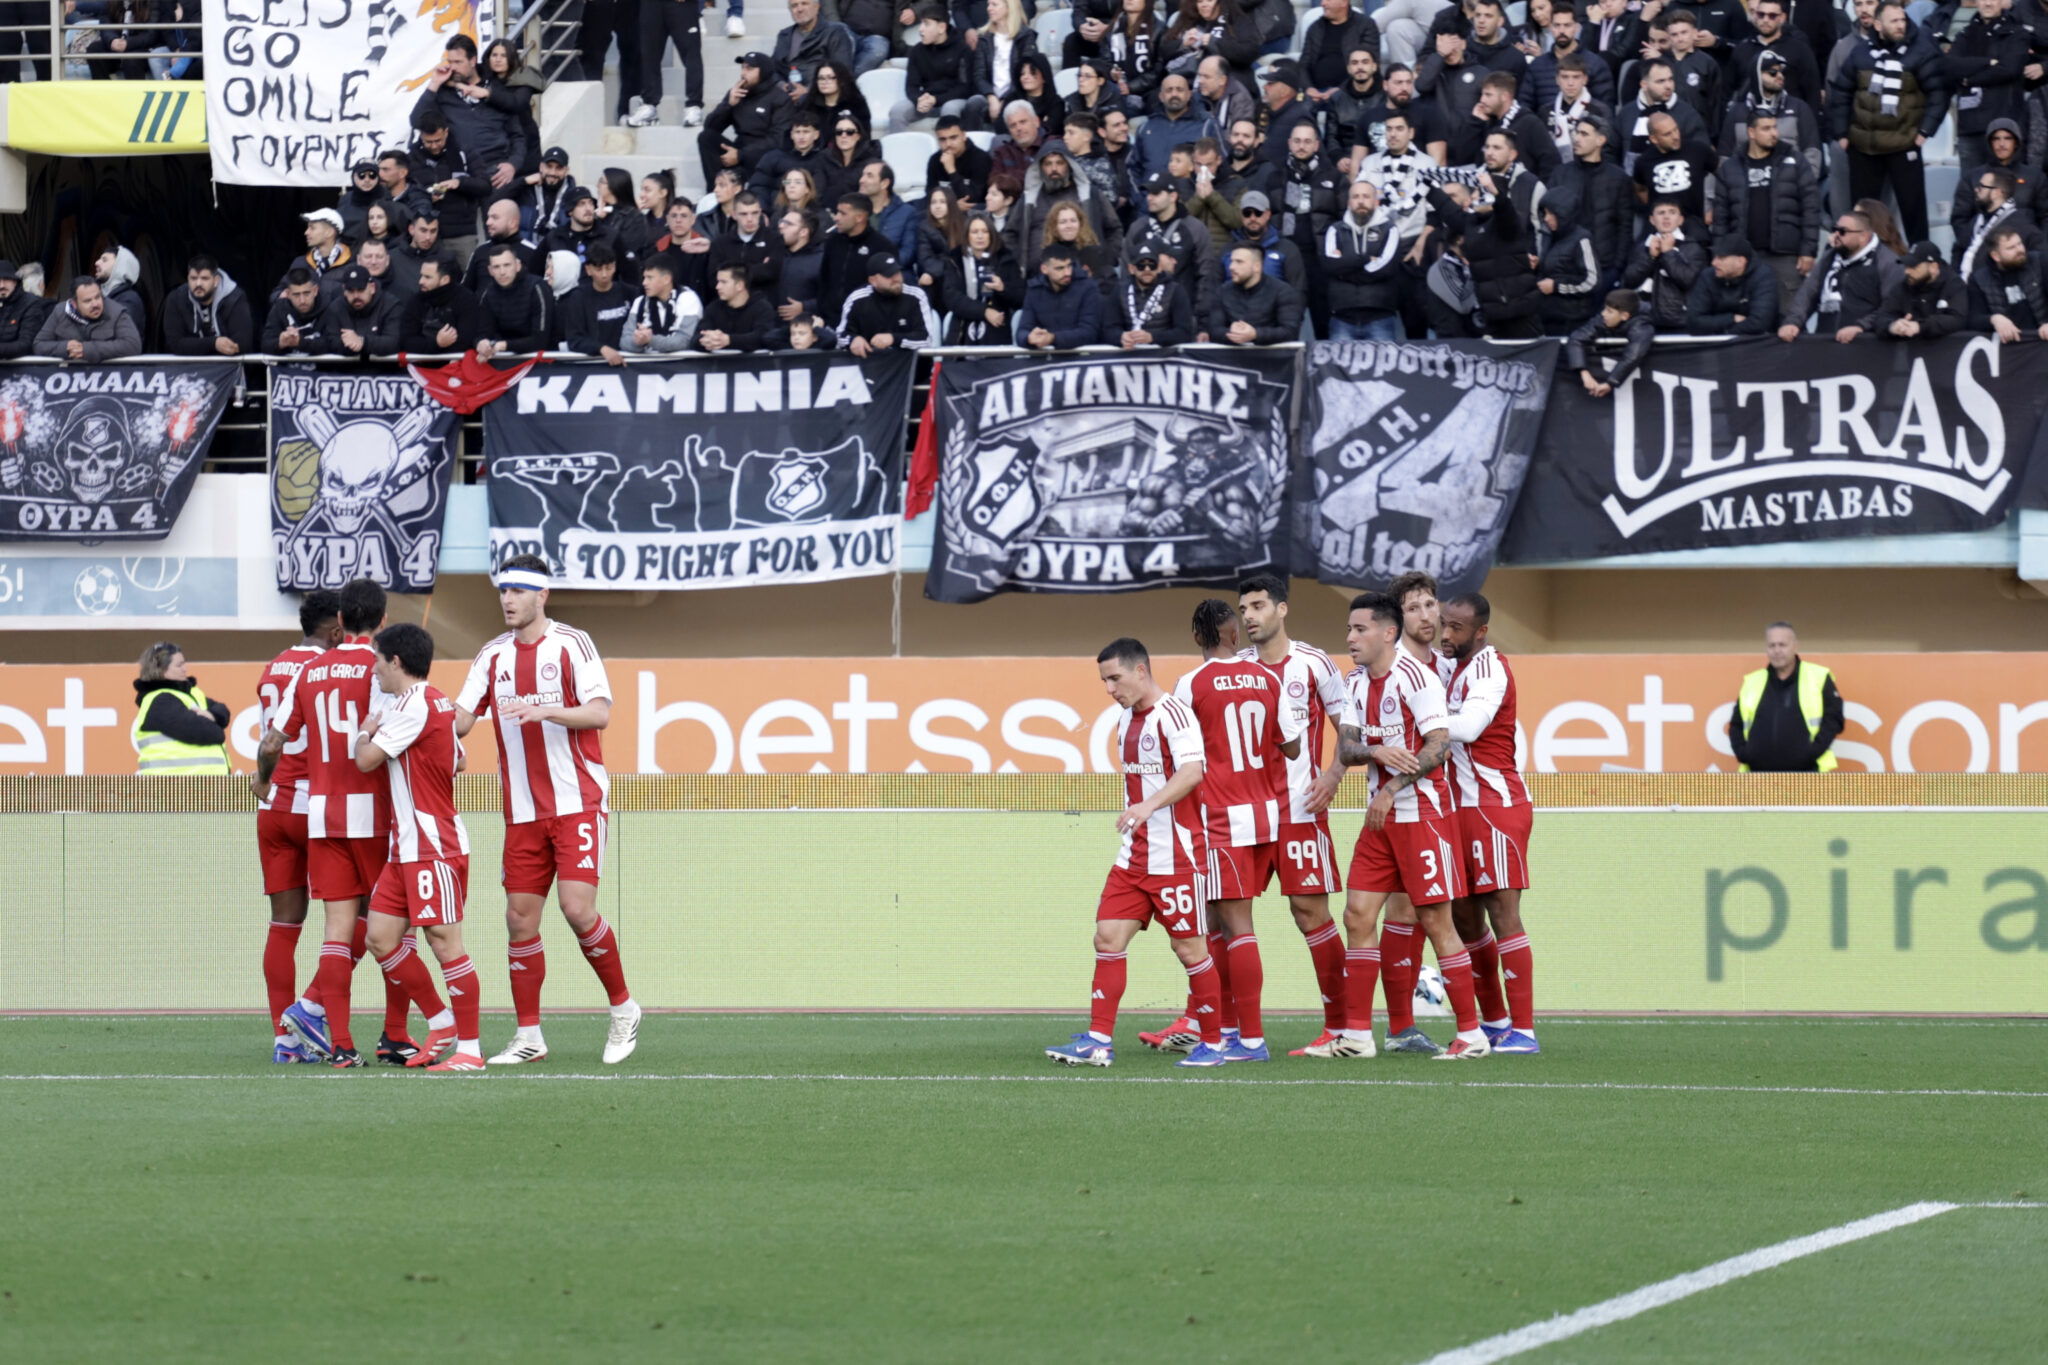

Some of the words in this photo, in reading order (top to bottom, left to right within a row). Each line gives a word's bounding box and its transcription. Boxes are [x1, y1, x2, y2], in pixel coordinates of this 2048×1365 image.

[223, 26, 300, 69] GO
[223, 69, 371, 123] OMILE
[45, 371, 171, 395] ΟΜΑΛΑ
[1313, 341, 1451, 378] support
[1451, 354, 1537, 392] your
[517, 365, 873, 414] KAMINIA
[979, 376, 1029, 430] ΑΙ
[1039, 364, 1250, 418] ΓΙΑΝΝΗΣ
[1602, 333, 2006, 499] ULTRAS
[515, 456, 599, 469] A.C.A.B
[18, 506, 118, 531] ΘΥΡΑ
[130, 503, 157, 529] 4
[1700, 484, 1913, 532] MASTABAS
[403, 532, 438, 586] 4
[578, 544, 626, 581] TO
[634, 541, 741, 581] FIGHT
[747, 535, 819, 576] FOR
[828, 526, 896, 570] YOU
[1143, 542, 1180, 576] 4
[307, 665, 330, 683] DANI
[330, 663, 368, 679] GARCIA
[315, 688, 359, 763] 14
[1224, 700, 1267, 773] 10
[578, 823, 594, 851] 5
[1287, 840, 1318, 869] 99
[417, 870, 434, 900] 8
[1419, 849, 1438, 880] 3
[1160, 884, 1193, 916] 56
[1705, 838, 2048, 982] pira
